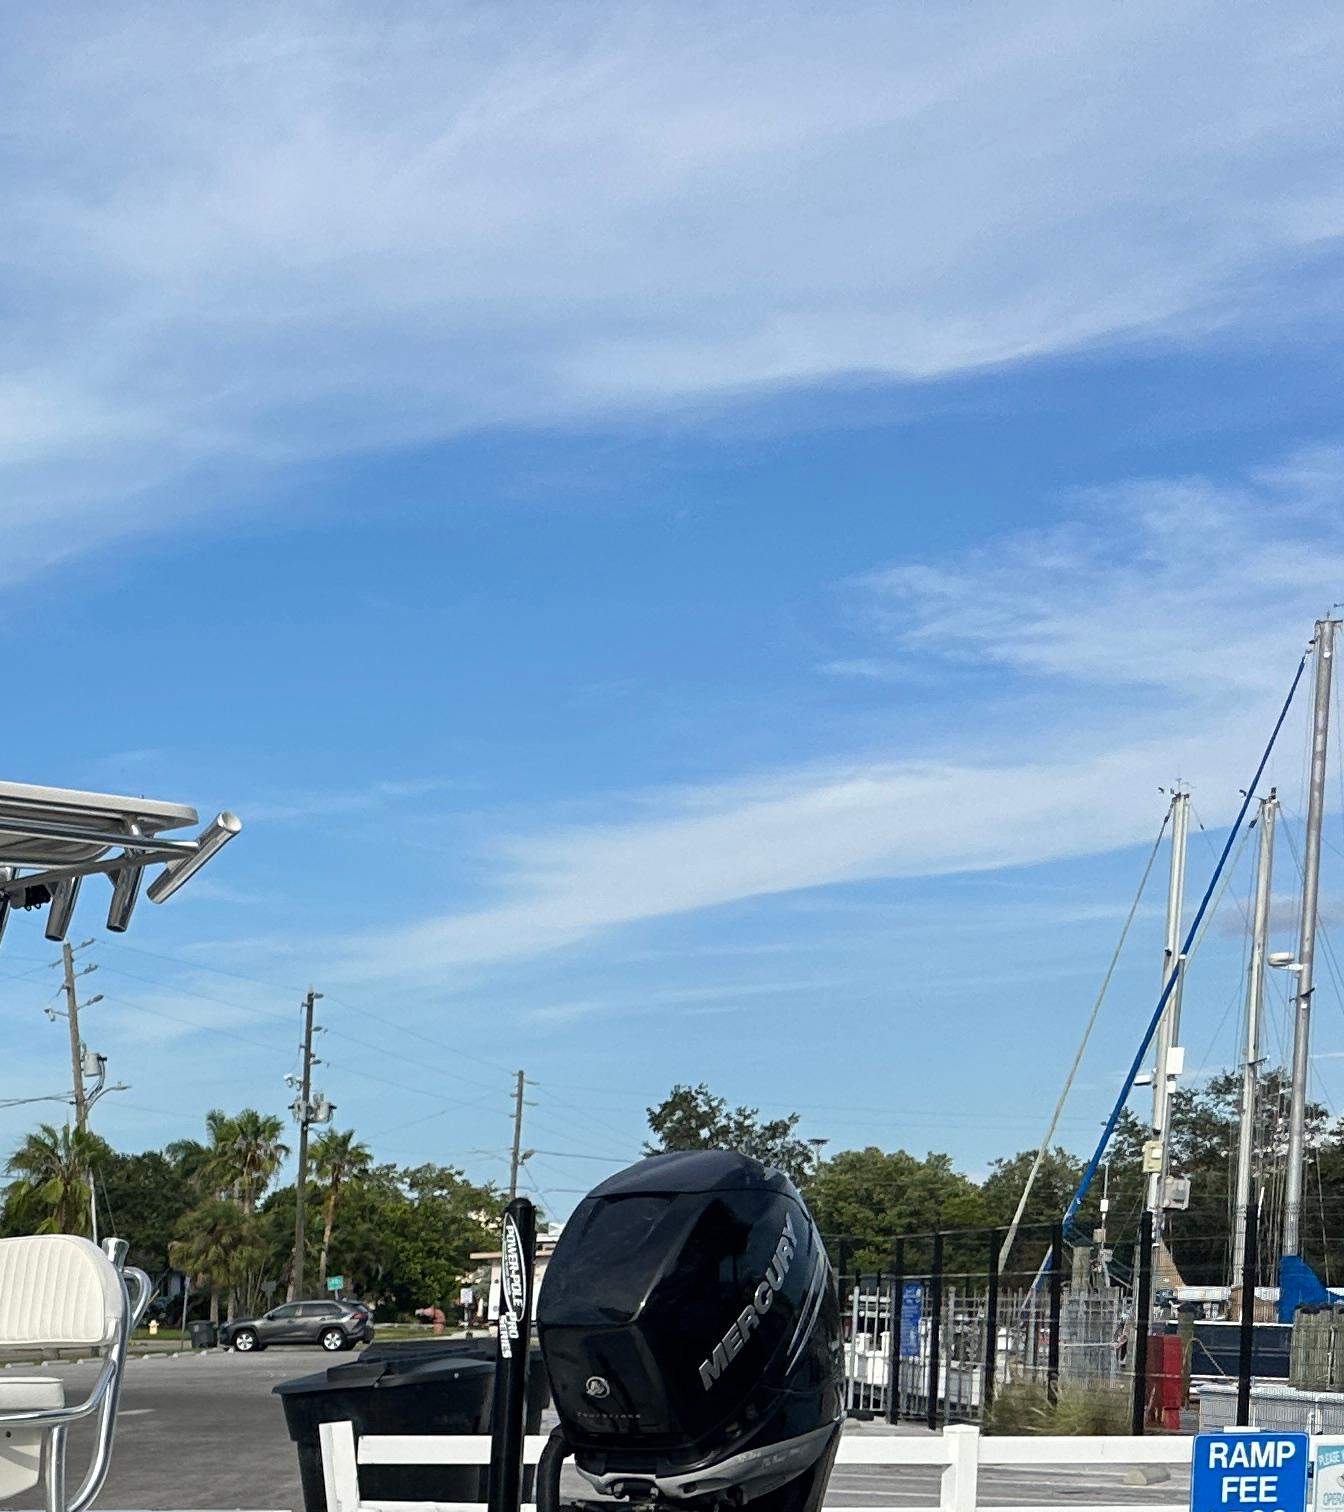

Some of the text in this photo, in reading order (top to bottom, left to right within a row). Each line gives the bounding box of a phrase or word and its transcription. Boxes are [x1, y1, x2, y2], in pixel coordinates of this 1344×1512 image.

[505, 1225, 523, 1308] POWER-POLE
[698, 1212, 798, 1391] MERCURY
[506, 1311, 519, 1339] PRO
[1208, 1440, 1296, 1469] RAMP
[1221, 1475, 1278, 1504] FEE
